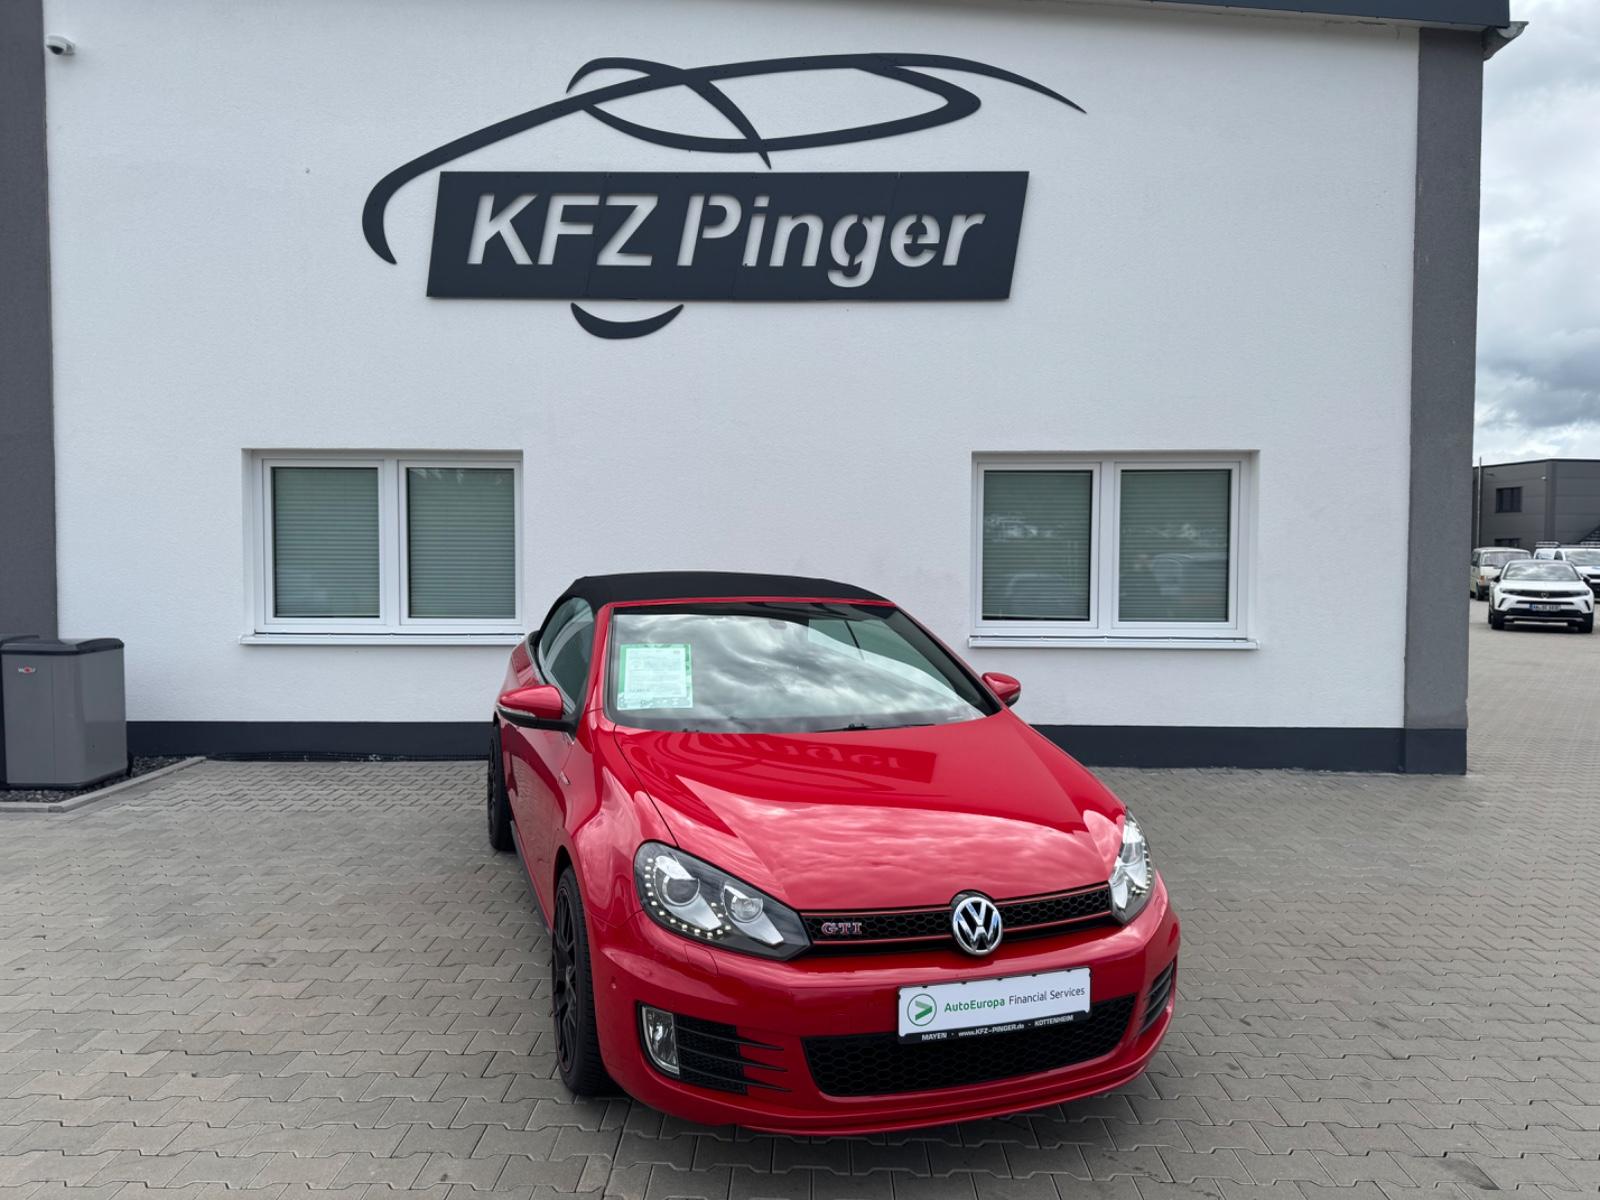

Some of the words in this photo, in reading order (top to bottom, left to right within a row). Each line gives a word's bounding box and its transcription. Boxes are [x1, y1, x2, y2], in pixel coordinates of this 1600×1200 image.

[467, 193, 660, 266] KFZ
[677, 193, 985, 288] Pinger
[821, 922, 863, 935] GTI
[944, 998, 1005, 1013] AutoEuropa
[1008, 991, 1048, 1006] Financial
[1049, 986, 1086, 1000] Services
[921, 1032, 947, 1041] MAYEN
[1034, 1014, 1074, 1027] KOTTENHEIM
